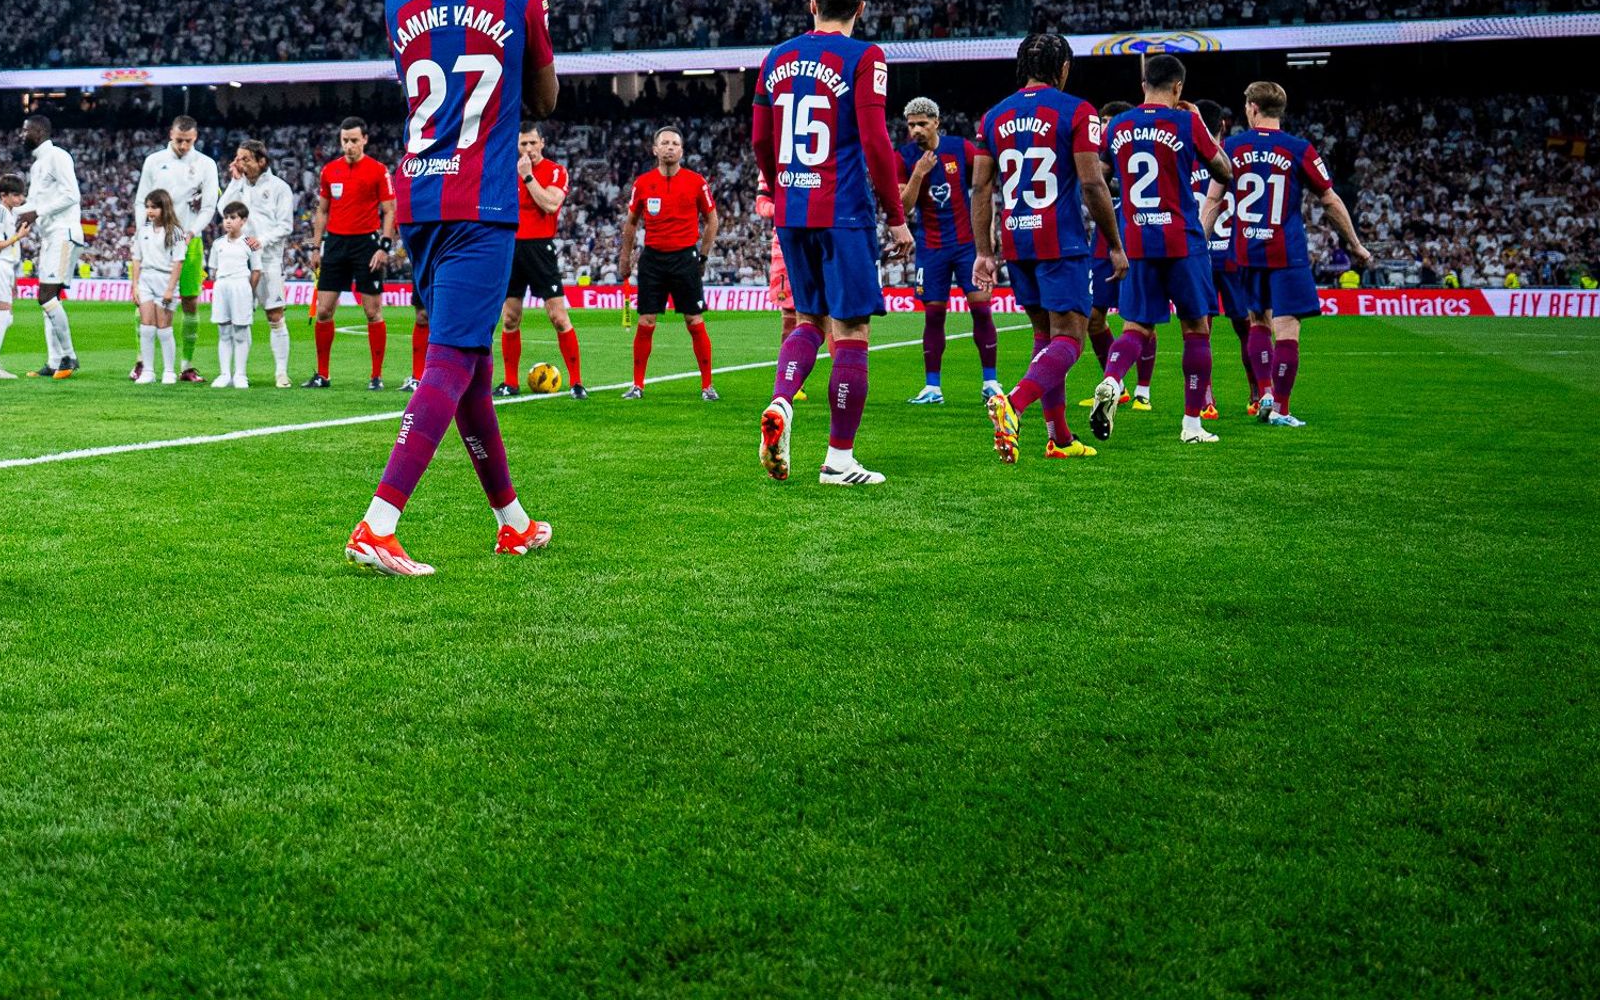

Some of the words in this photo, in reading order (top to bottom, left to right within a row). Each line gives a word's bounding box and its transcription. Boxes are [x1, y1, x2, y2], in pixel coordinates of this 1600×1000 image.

[393, 5, 448, 54] LAMINE
[453, 5, 514, 48] YAMAL
[765, 60, 850, 98] CHRISTENSEN
[406, 53, 504, 154] 27
[774, 93, 832, 166] 15
[998, 116, 1052, 139] KOUNDE
[1110, 129, 1133, 155] JOÃO
[1133, 127, 1185, 153] CANCELO
[1243, 151, 1259, 163] DE
[1259, 150, 1292, 171] JONG
[998, 146, 1059, 210] 23
[1127, 151, 1162, 208] 2
[1237, 172, 1286, 226] 21
[915, 267, 924, 285] 4
[100, 282, 133, 301] BETT
[727, 288, 771, 310] BETTE
[1357, 294, 1471, 316] Emirates
[1509, 293, 1542, 317] FLY
[1548, 293, 1600, 318] BETT
[397, 412, 415, 445] BARÇA
